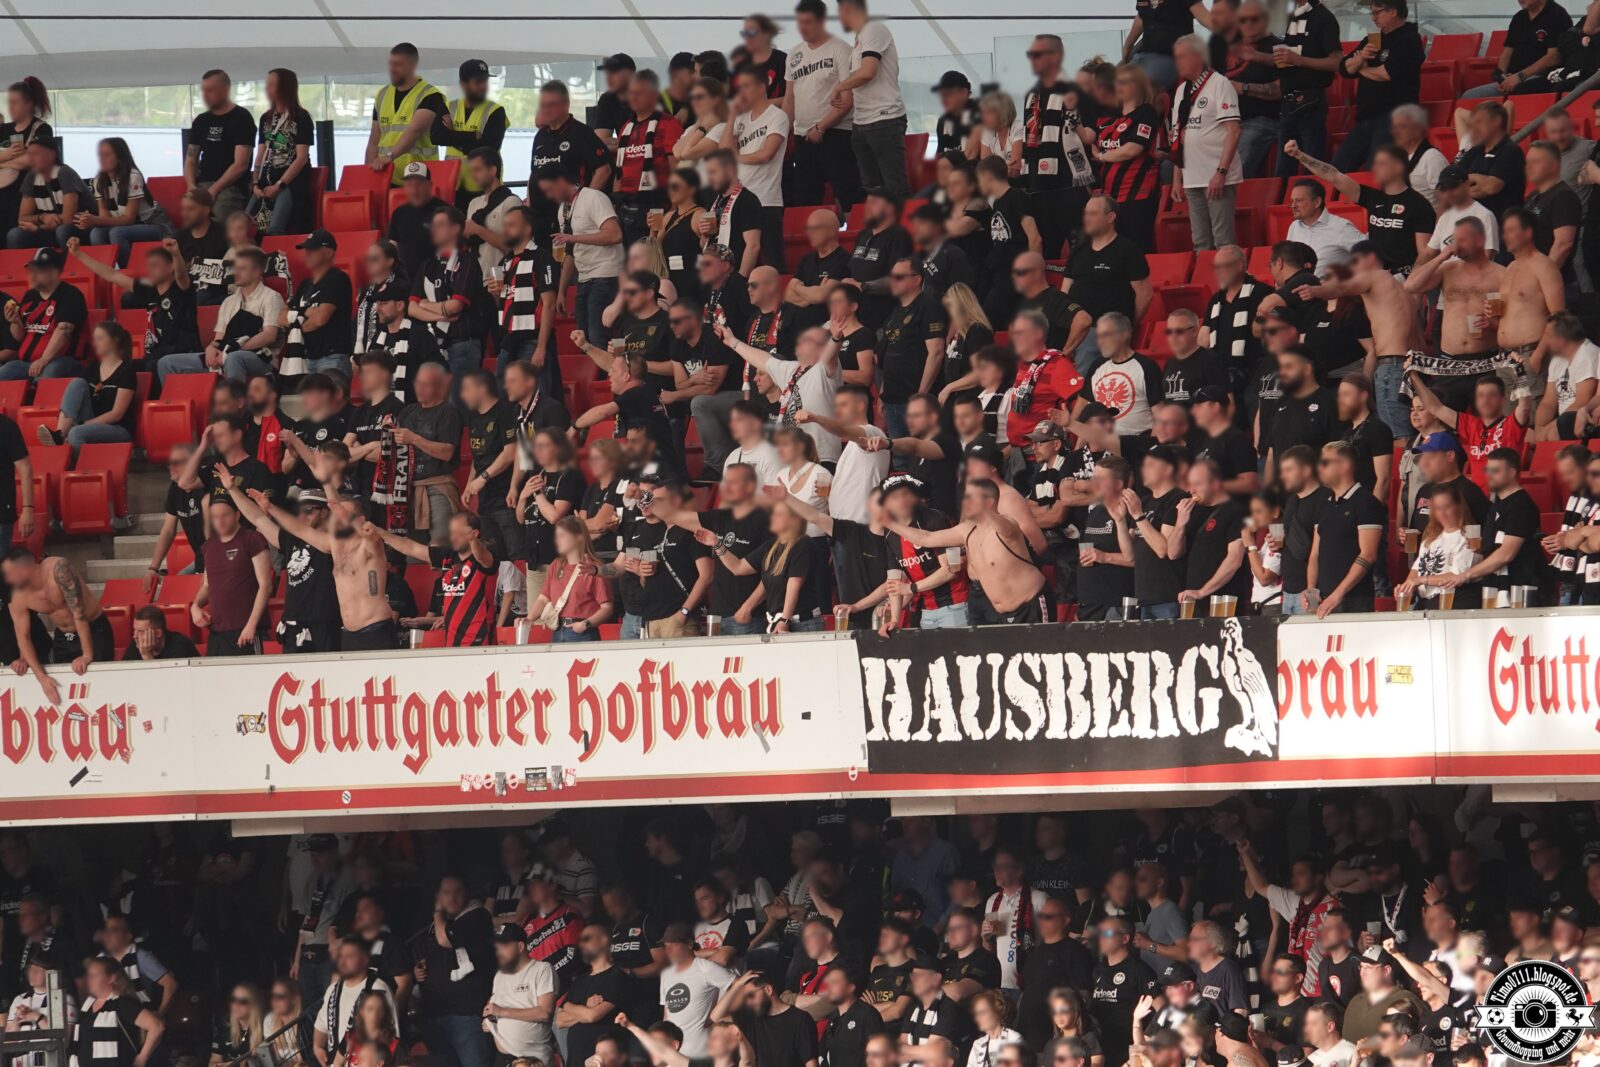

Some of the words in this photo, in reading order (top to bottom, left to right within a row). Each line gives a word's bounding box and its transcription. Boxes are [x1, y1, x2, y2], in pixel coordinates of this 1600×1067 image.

[268, 671, 557, 775] Stuttgarter
[567, 656, 784, 763] Hofbräu
[861, 643, 1224, 742] HAUSBERG
[1488, 626, 1600, 733] Stutt
